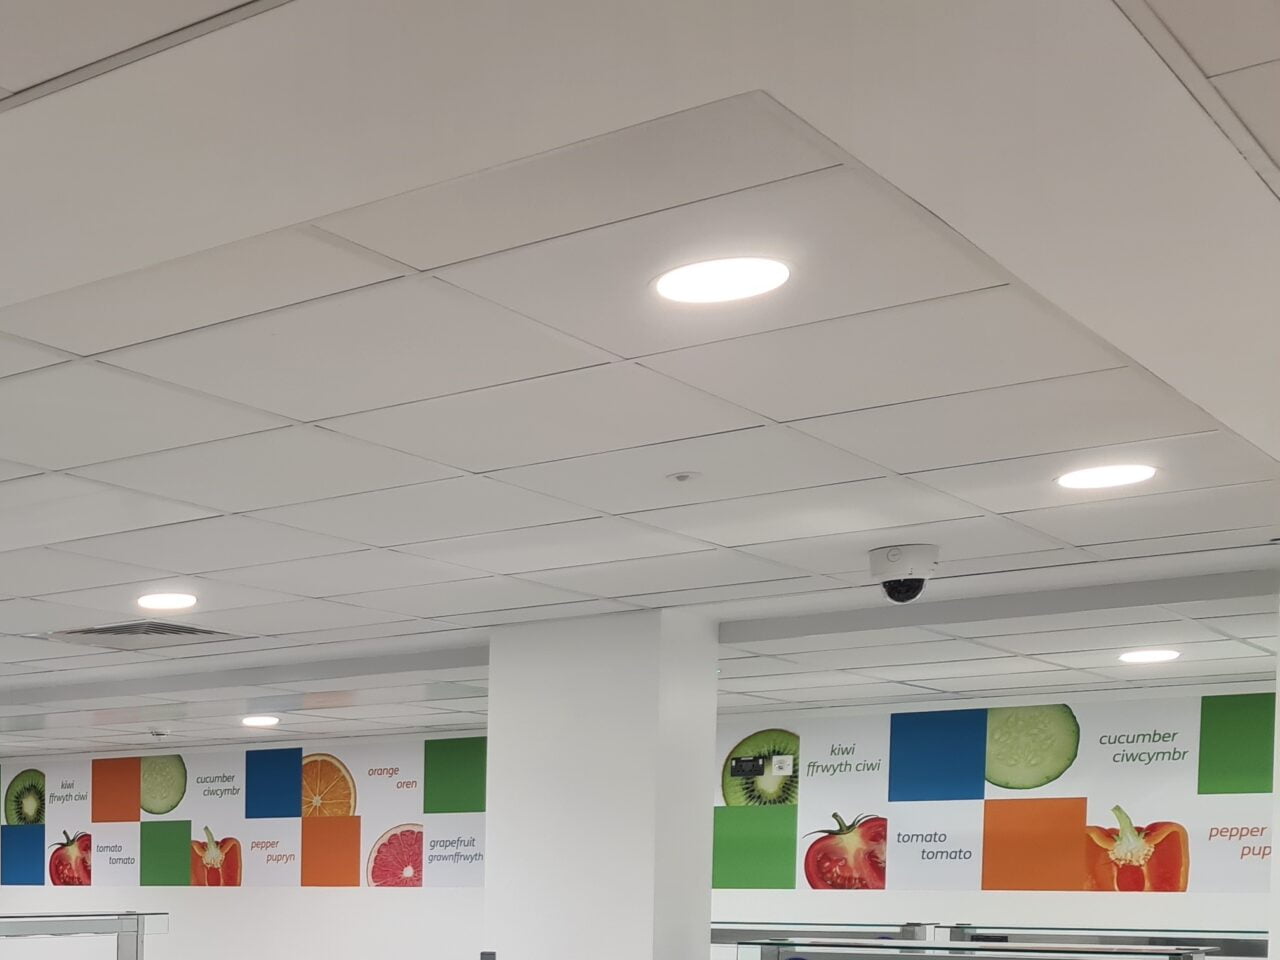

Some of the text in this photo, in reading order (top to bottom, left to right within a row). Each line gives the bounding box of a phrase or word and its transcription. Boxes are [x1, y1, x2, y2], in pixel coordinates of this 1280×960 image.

[1099, 729, 1179, 746] cucumber
[830, 742, 856, 756] kiwi
[1112, 747, 1189, 765] ciwcymbr
[367, 765, 400, 778] orange
[806, 758, 882, 777] ffrwyth ciwi
[60, 779, 75, 790] kiwi
[196, 772, 235, 784] cucumber
[396, 779, 418, 790] oren
[48, 791, 88, 804] ffrwyth ciwi
[202, 785, 241, 798] ciwcymbr
[896, 831, 947, 844] tomato
[1208, 826, 1269, 841] pepper
[96, 843, 123, 853] tomato
[250, 839, 280, 851] pepper
[429, 836, 476, 849] grapefruit
[108, 855, 136, 865] tomato
[266, 852, 296, 863] pupryn
[921, 848, 972, 861] tomato
